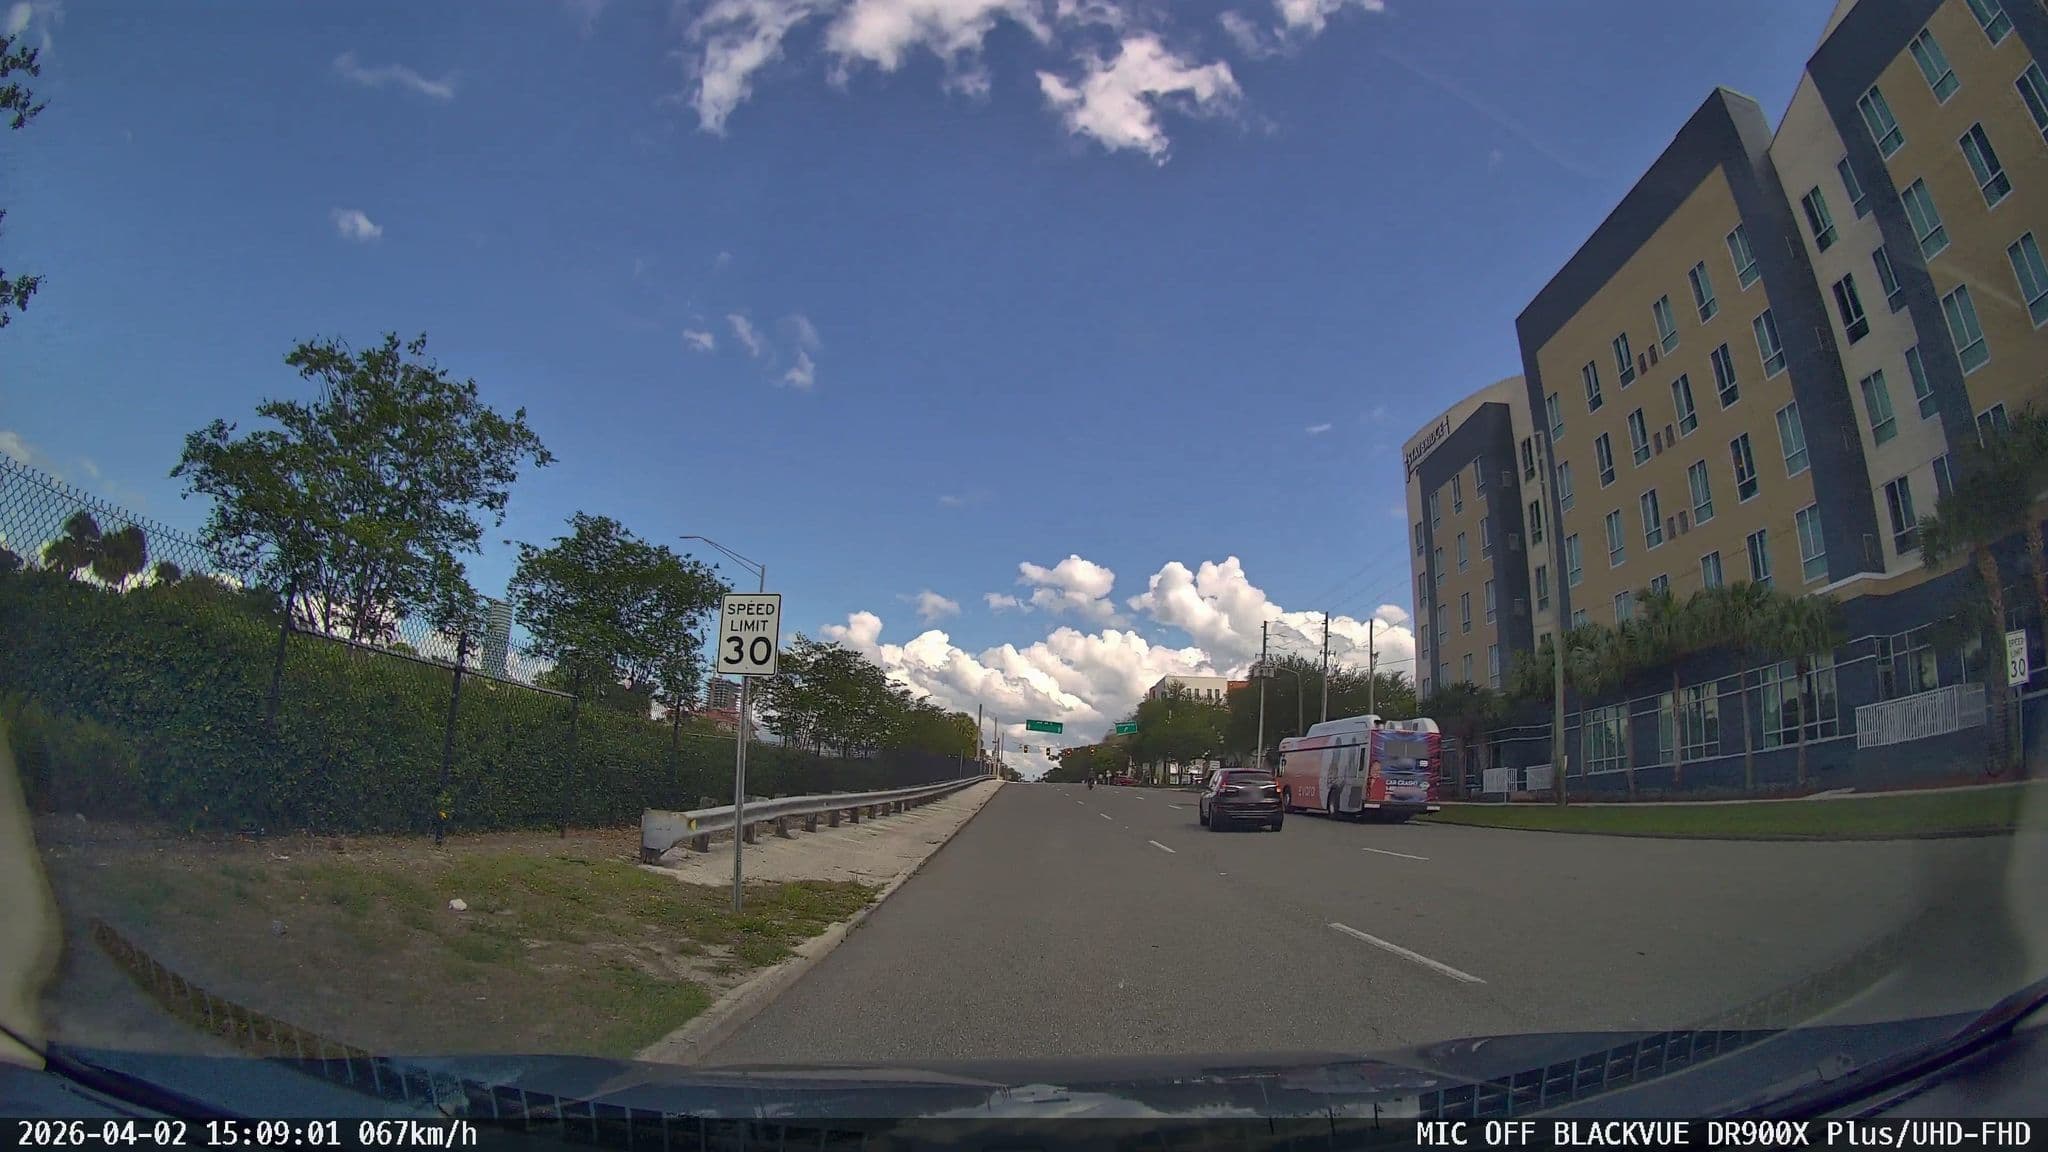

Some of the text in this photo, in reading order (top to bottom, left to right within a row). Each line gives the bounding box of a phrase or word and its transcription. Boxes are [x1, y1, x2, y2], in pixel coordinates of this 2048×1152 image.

[727, 603, 775, 615] SPEED
[730, 620, 768, 632] LIMIT
[723, 636, 772, 665] 30
[2011, 658, 2025, 678] 30
